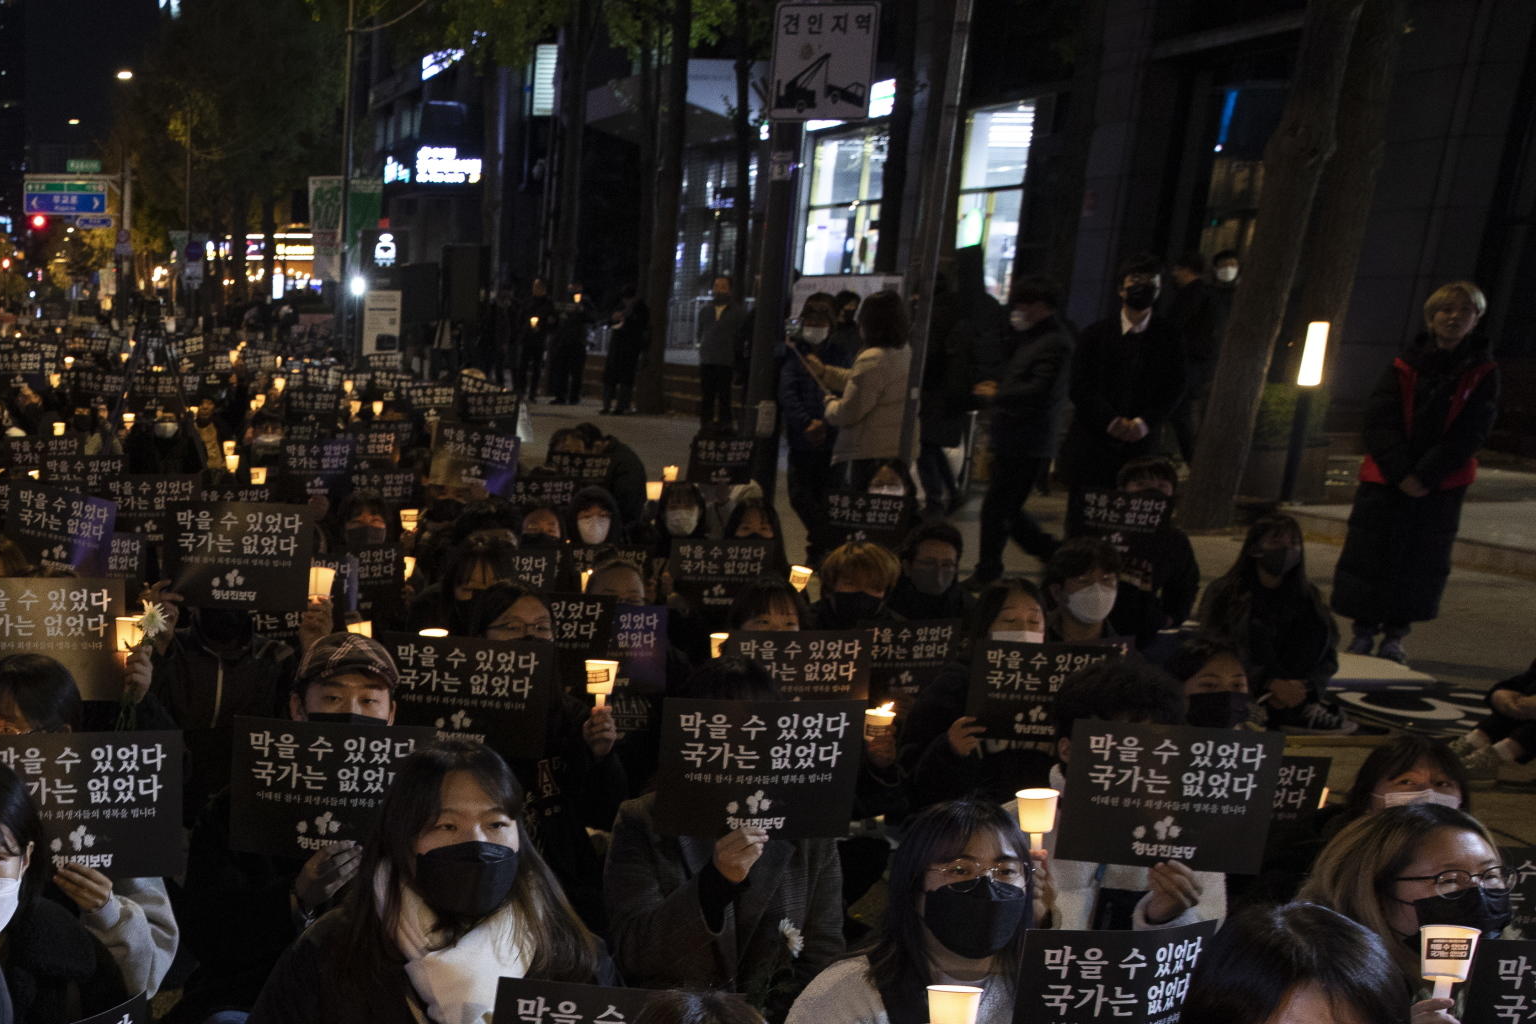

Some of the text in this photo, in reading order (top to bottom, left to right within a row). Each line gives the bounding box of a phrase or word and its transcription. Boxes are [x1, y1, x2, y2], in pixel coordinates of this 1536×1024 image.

[784, 13, 871, 35] 견인지역
[177, 509, 303, 533] 막을 수 있었다
[177, 532, 299, 557] 국가는 없었다
[18, 589, 39, 611] 수
[47, 588, 112, 613] 있었다
[44, 614, 109, 638] 없었다
[398, 643, 540, 675] 막을 수 있었다
[398, 669, 534, 699] 국가는 없었다
[680, 712, 732, 740] 막을
[740, 715, 767, 741] 수
[777, 712, 850, 741] 있었다
[55, 747, 82, 774] 수
[90, 743, 167, 773] 있었다
[249, 730, 300, 759] 막을
[308, 736, 334, 761] 수
[680, 742, 842, 770] 국가는 없었다
[1089, 734, 1267, 771] 막을 수 있었다
[26, 774, 163, 805] 가는 없었다
[252, 761, 327, 790] 국가는
[1088, 764, 1257, 800] 국가는 없었다
[1044, 936, 1202, 980] 막을 수 있었다
[1041, 973, 1192, 1017] 국가는 없었다
